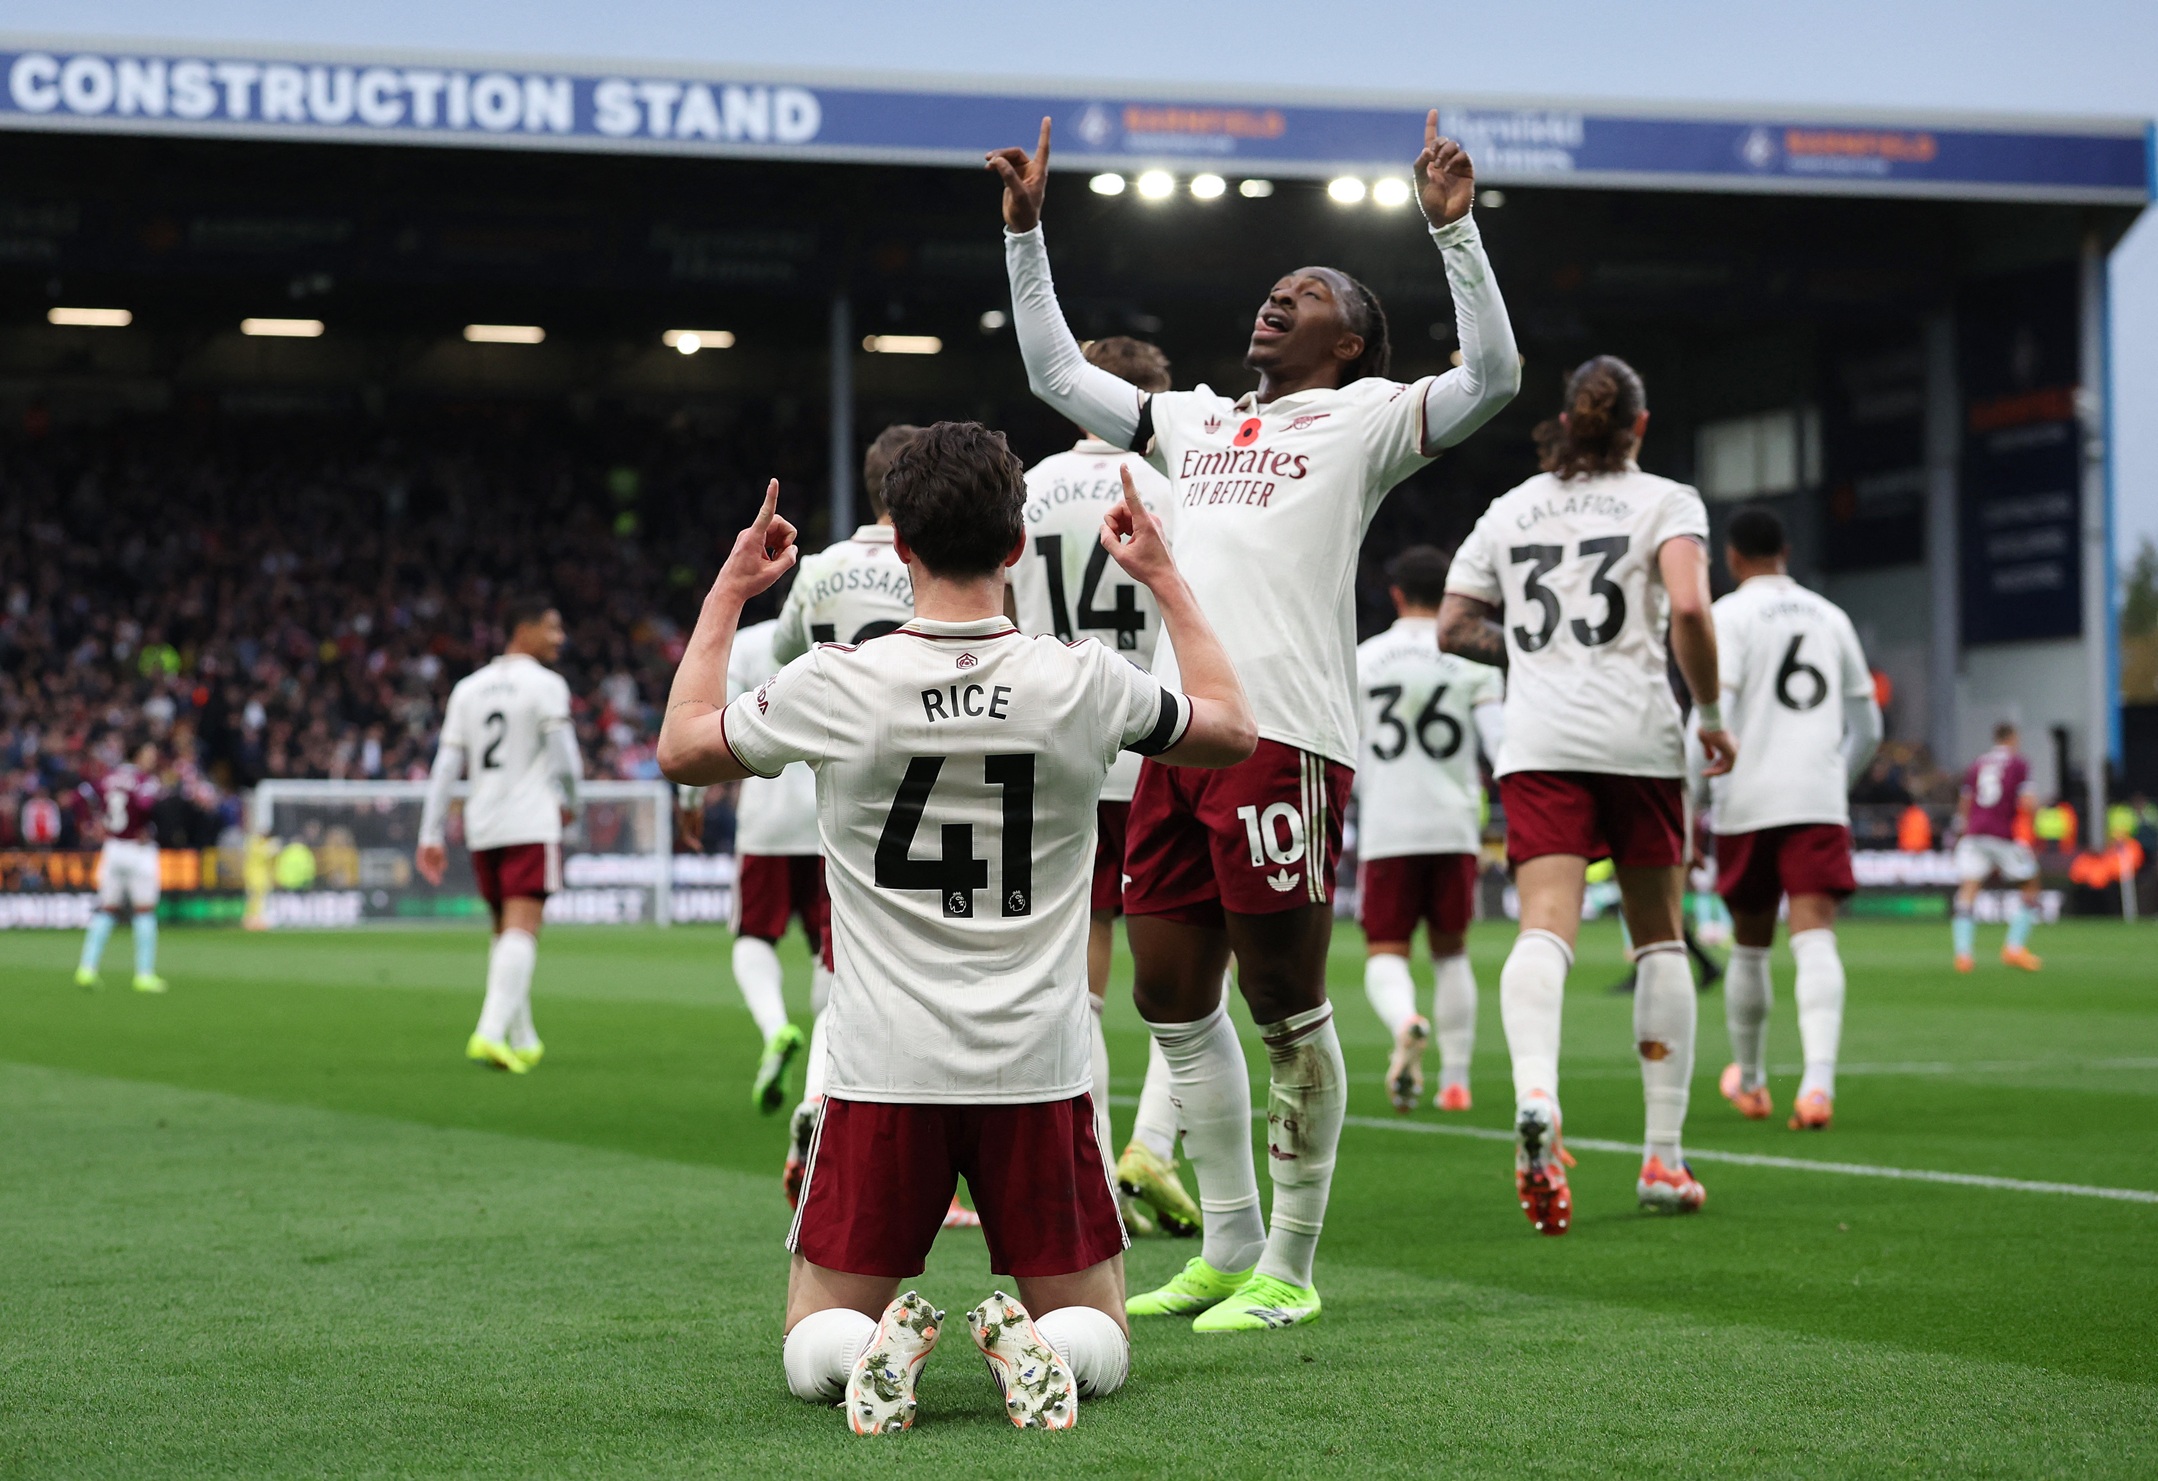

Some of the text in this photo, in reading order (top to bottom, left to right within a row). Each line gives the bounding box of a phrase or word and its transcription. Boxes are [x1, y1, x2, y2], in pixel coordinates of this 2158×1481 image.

[9, 54, 822, 143] CONSTRUCTION STAND
[1180, 445, 1310, 480] Emirates
[1183, 480, 1275, 509] FLY BETTER
[1035, 531, 1145, 650] 14
[1510, 535, 1630, 652] 33
[920, 683, 1012, 723] RICE
[1776, 633, 1828, 711] 6
[482, 711, 508, 769] 2
[1369, 683, 1463, 761] 36
[874, 753, 1035, 918] 41
[1237, 802, 1305, 867] 10
